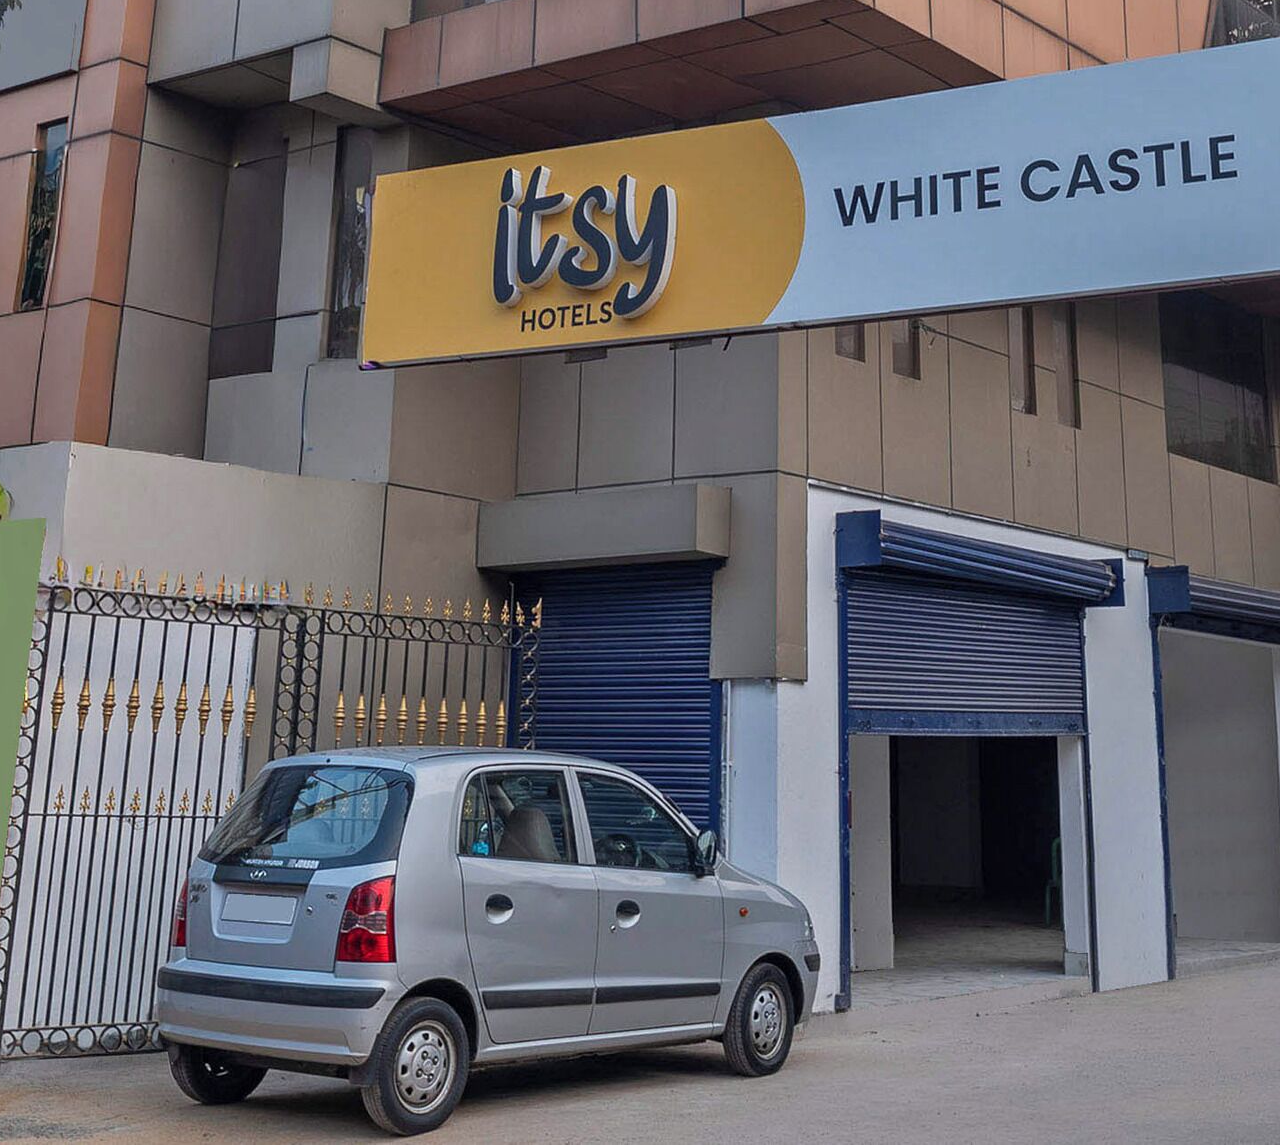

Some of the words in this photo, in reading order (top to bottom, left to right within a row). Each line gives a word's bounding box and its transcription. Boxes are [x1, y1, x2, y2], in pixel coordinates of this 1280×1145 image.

[832, 165, 1002, 228] WHITE
[1019, 133, 1239, 203] CASTLE
[492, 164, 678, 320] itsy
[520, 300, 614, 333] HOTELS
